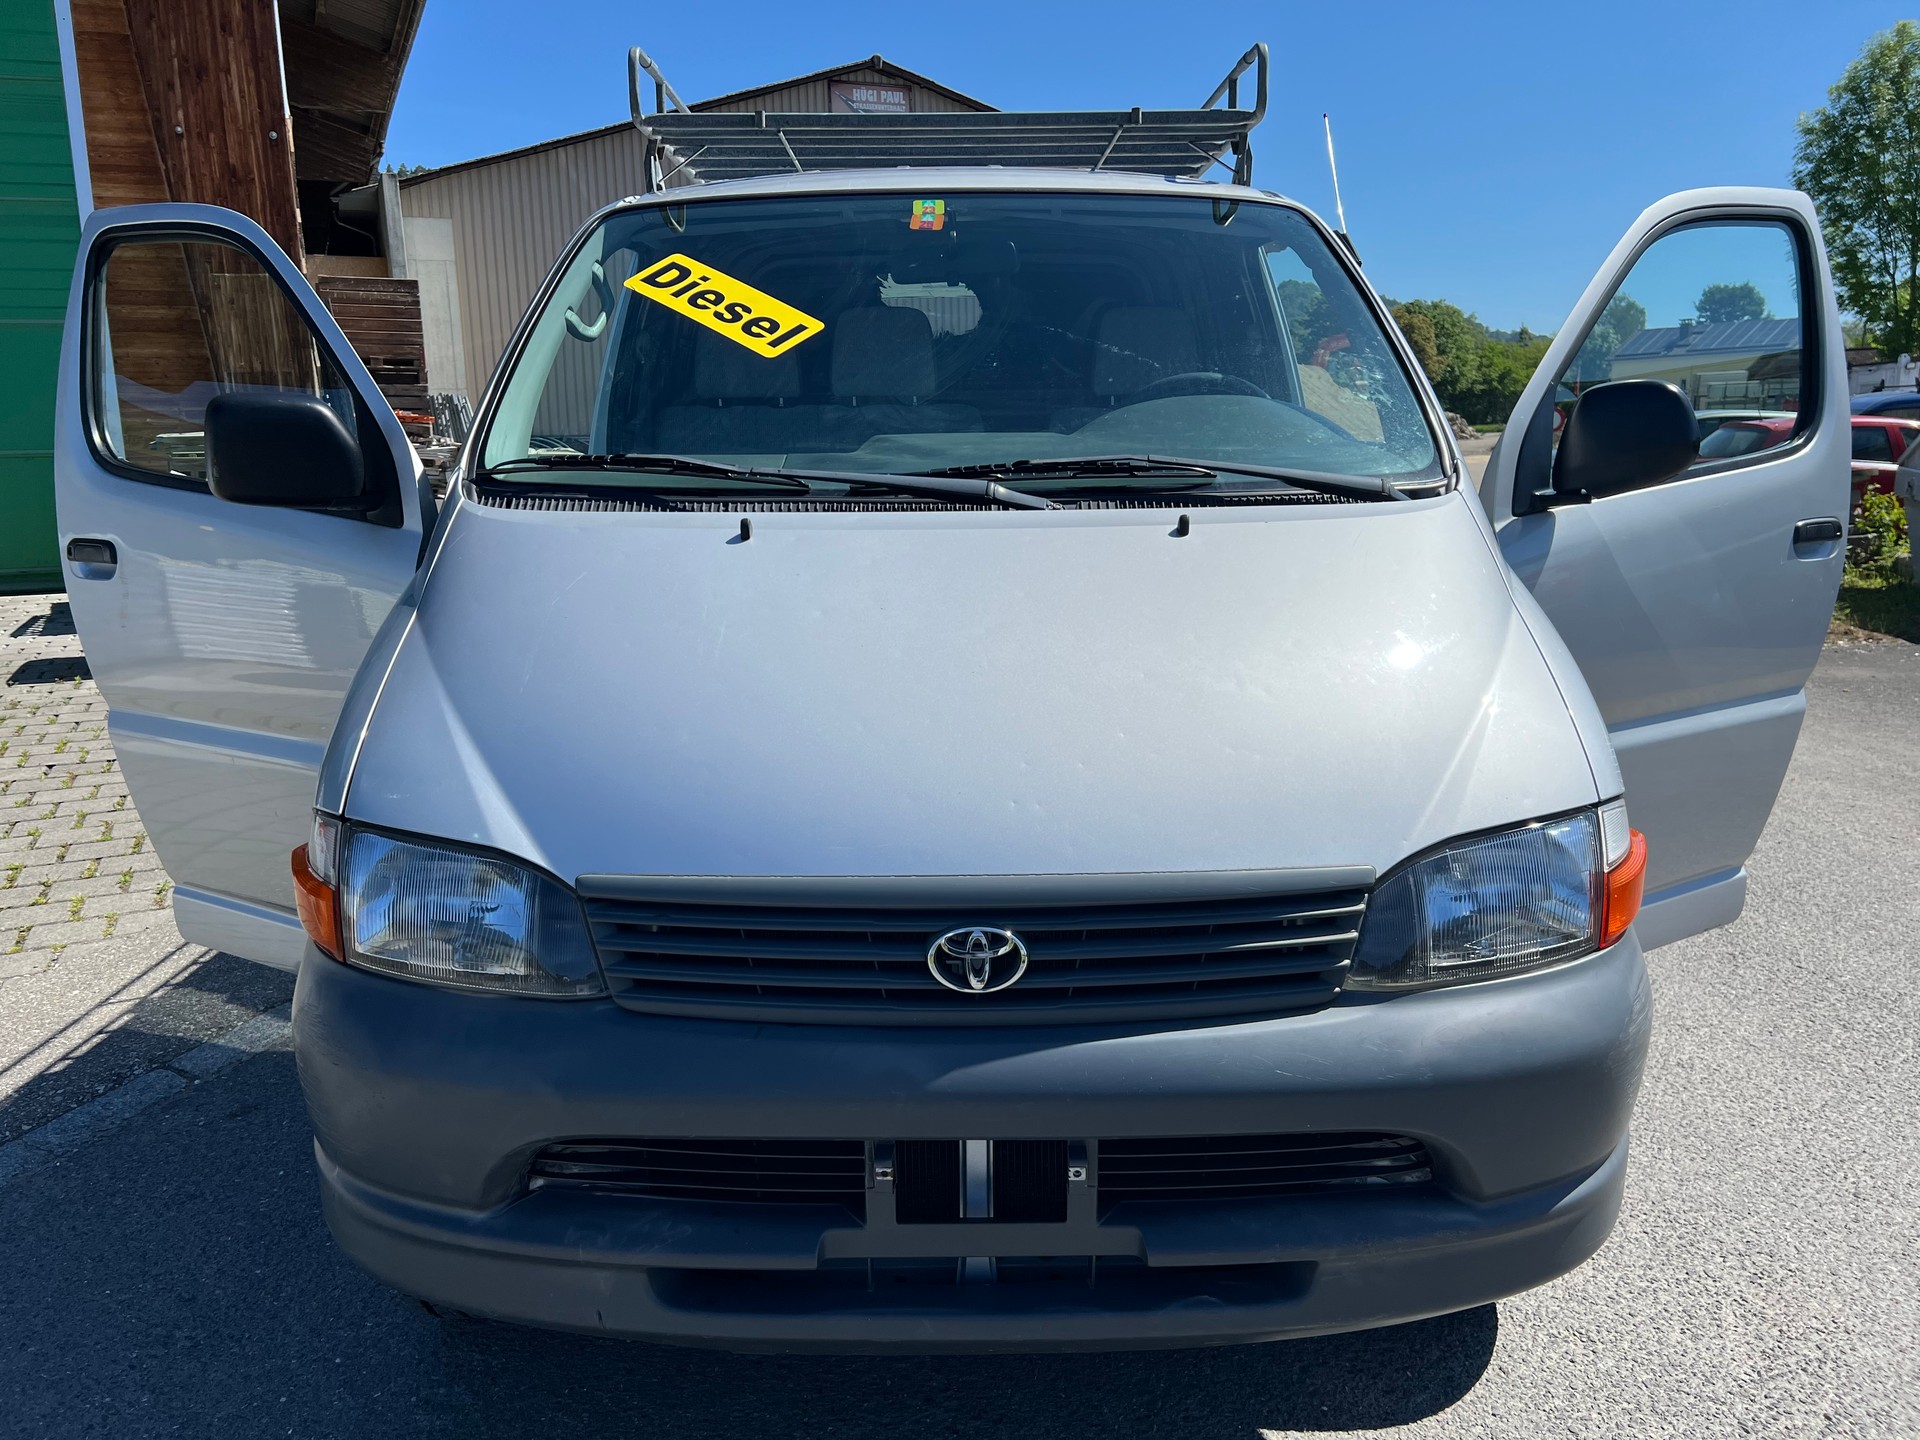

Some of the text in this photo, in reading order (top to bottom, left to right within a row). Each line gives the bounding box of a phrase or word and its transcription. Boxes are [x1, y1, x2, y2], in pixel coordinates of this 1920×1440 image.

[852, 87, 906, 104] HÜGI PAUL
[639, 261, 809, 349] Diesel
